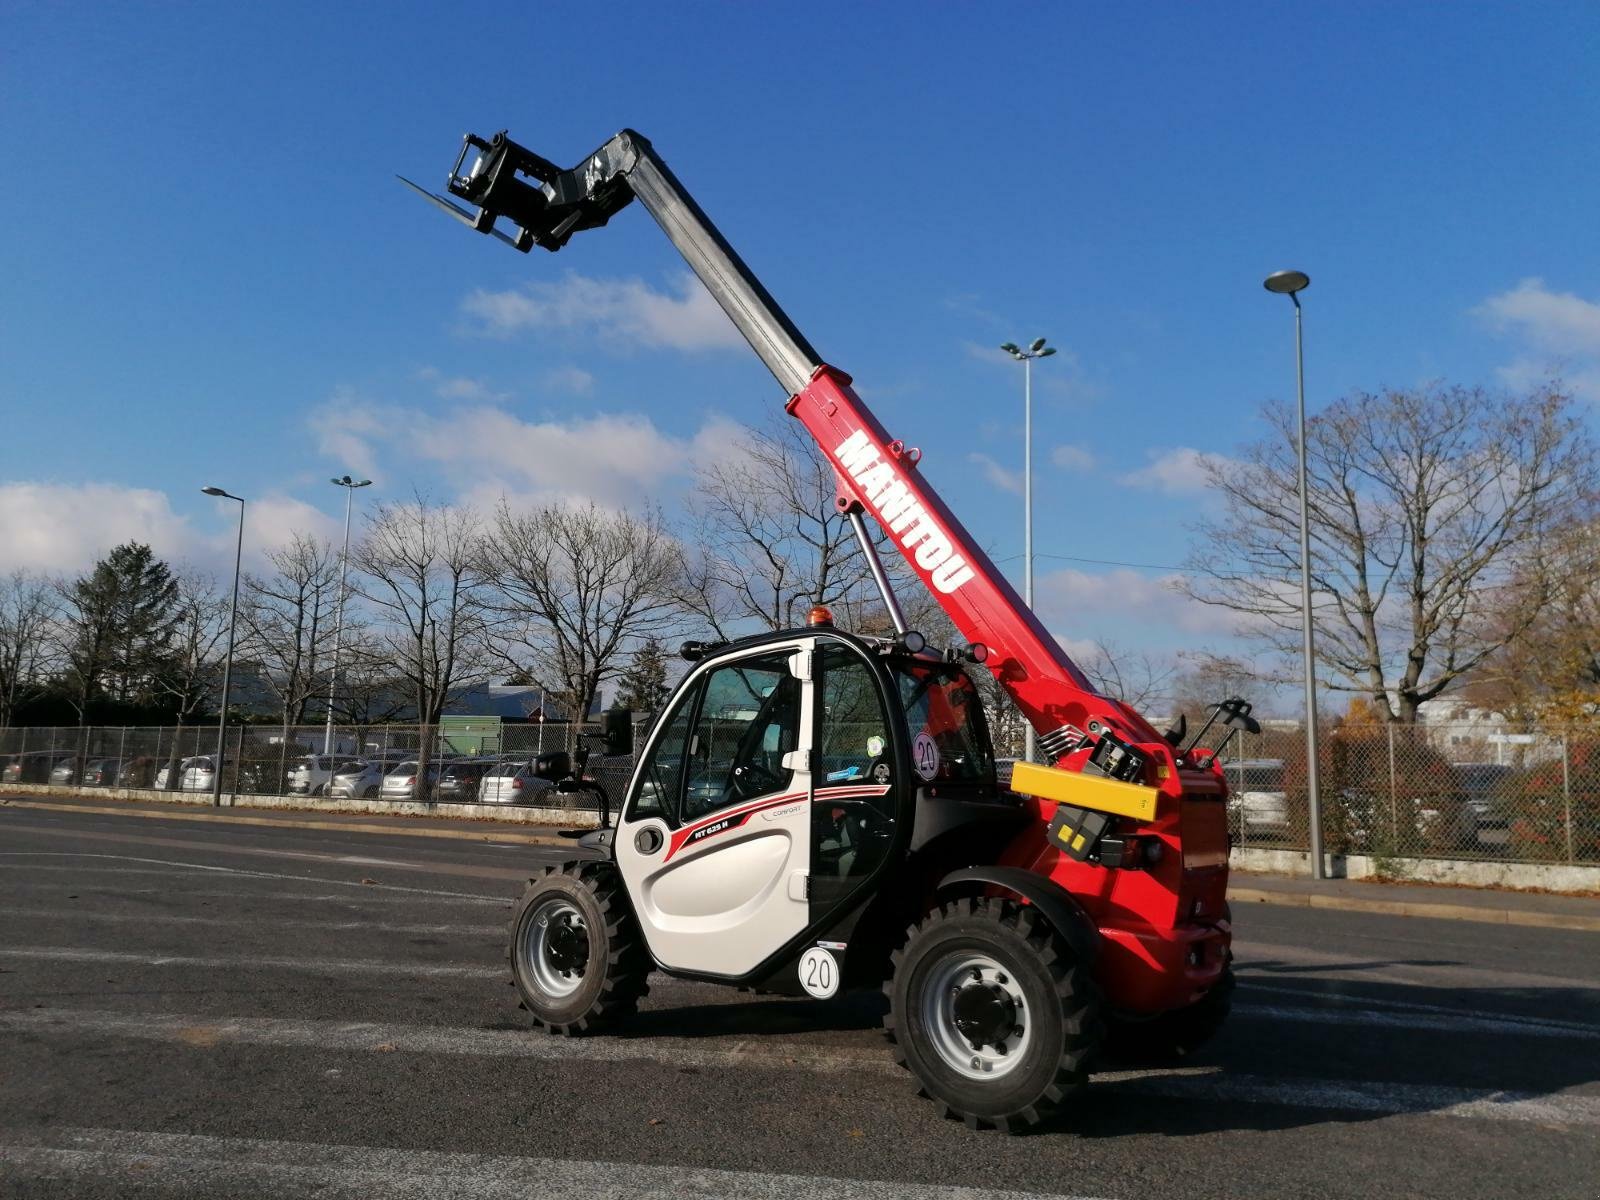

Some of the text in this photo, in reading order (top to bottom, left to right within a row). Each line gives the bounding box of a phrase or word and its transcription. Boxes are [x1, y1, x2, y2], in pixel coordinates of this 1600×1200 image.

[834, 428, 976, 594] MANITOU
[918, 741, 935, 771] 20
[772, 806, 801, 817] COMFORT
[807, 957, 830, 989] 20
